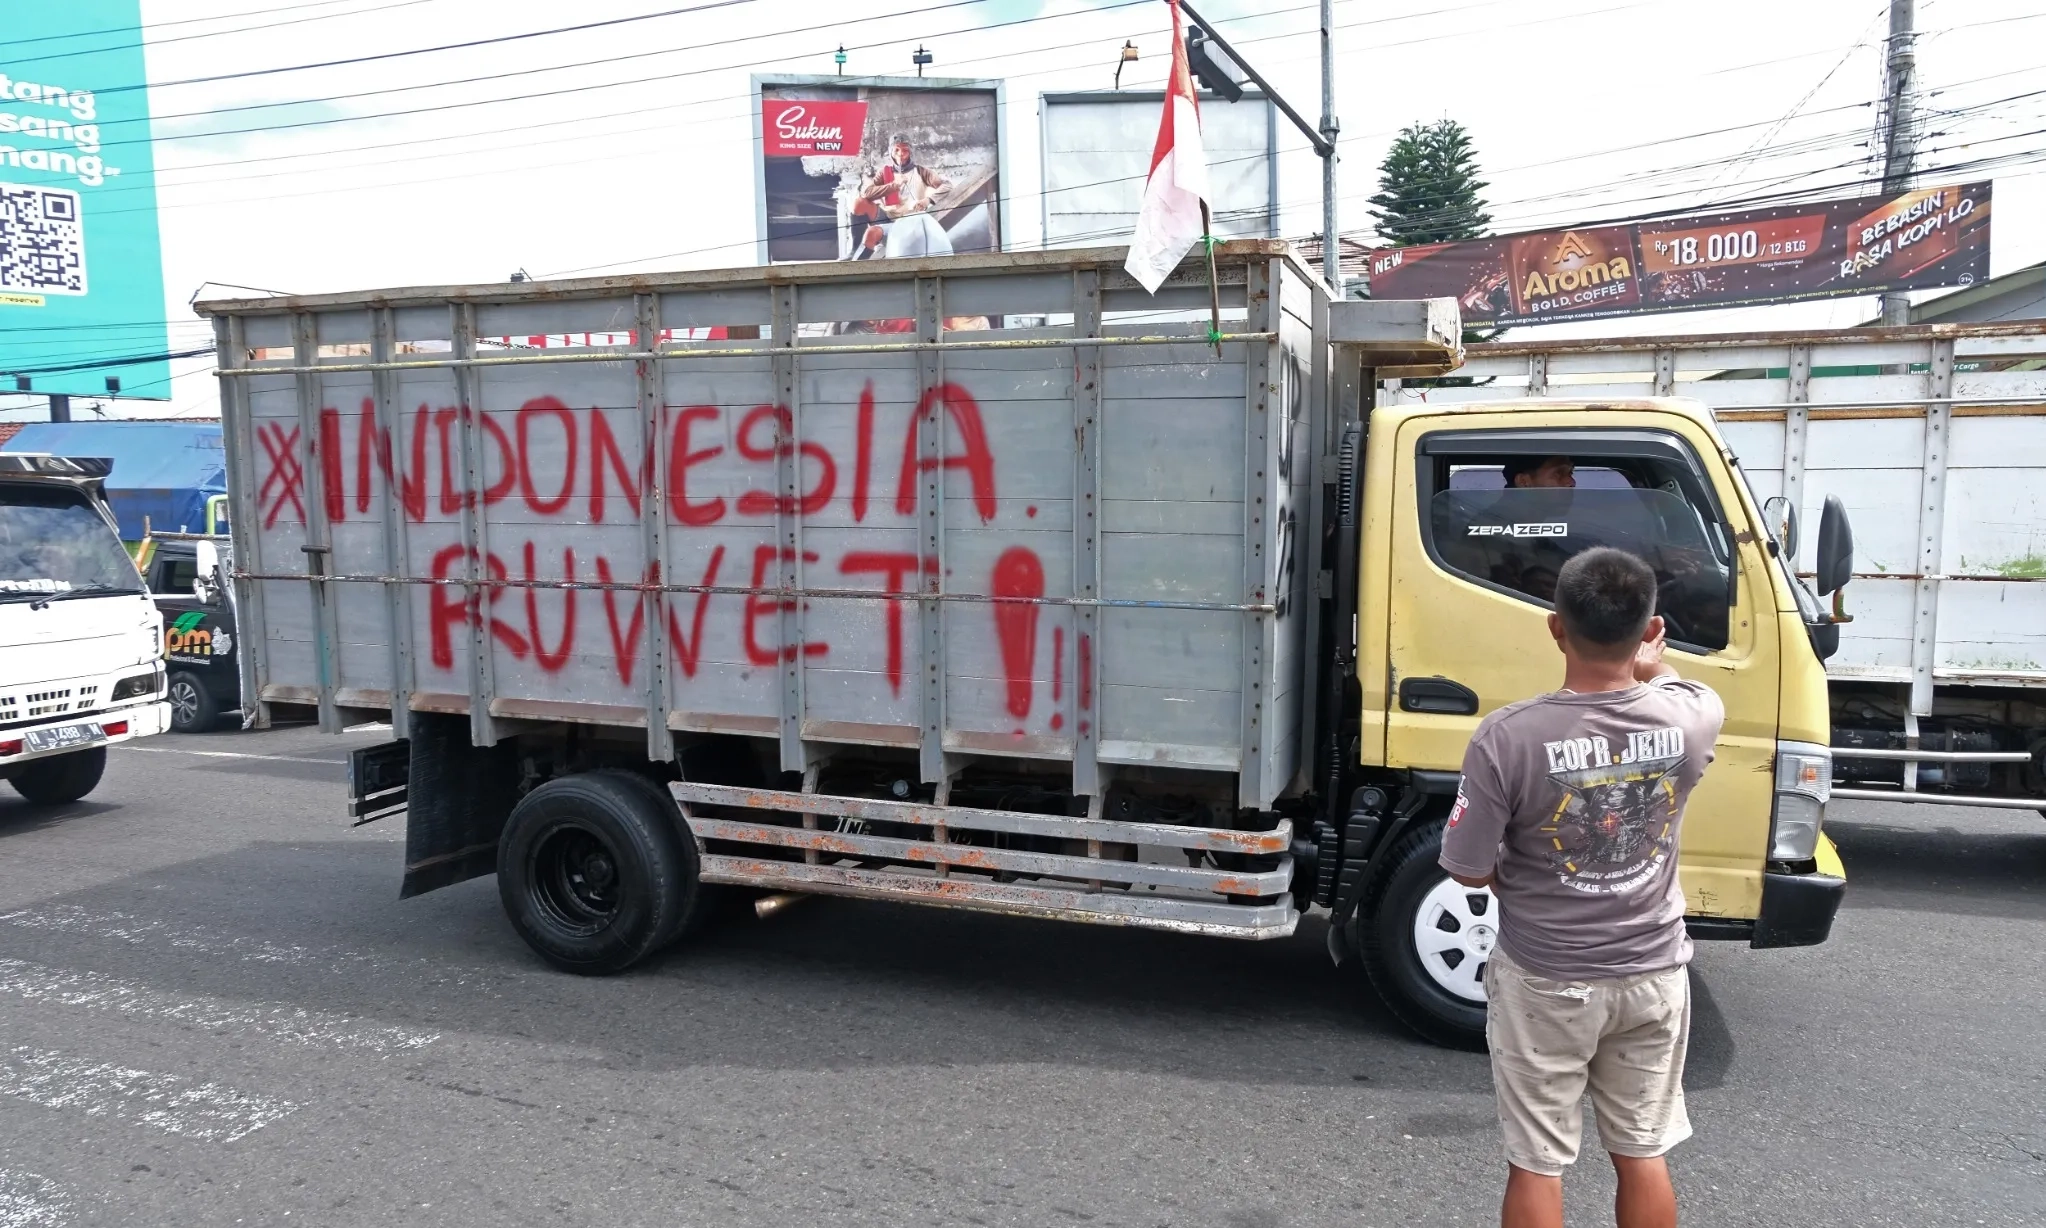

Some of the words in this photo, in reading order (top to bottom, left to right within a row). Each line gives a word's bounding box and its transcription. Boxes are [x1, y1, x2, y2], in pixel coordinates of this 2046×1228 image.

[776, 106, 843, 139] Sukun
[816, 142, 841, 151] NEW
[1861, 190, 1942, 246] BEBASIN
[1897, 213, 1942, 249] KOPI
[1769, 243, 1781, 255] 12
[1374, 250, 1403, 276] NEW
[1522, 255, 1632, 301] Aroma
[1574, 282, 1626, 304] COFFEE
[1959, 362, 1980, 371] Cargo
[27, 732, 41, 745] H
[51, 726, 81, 740] 1488
